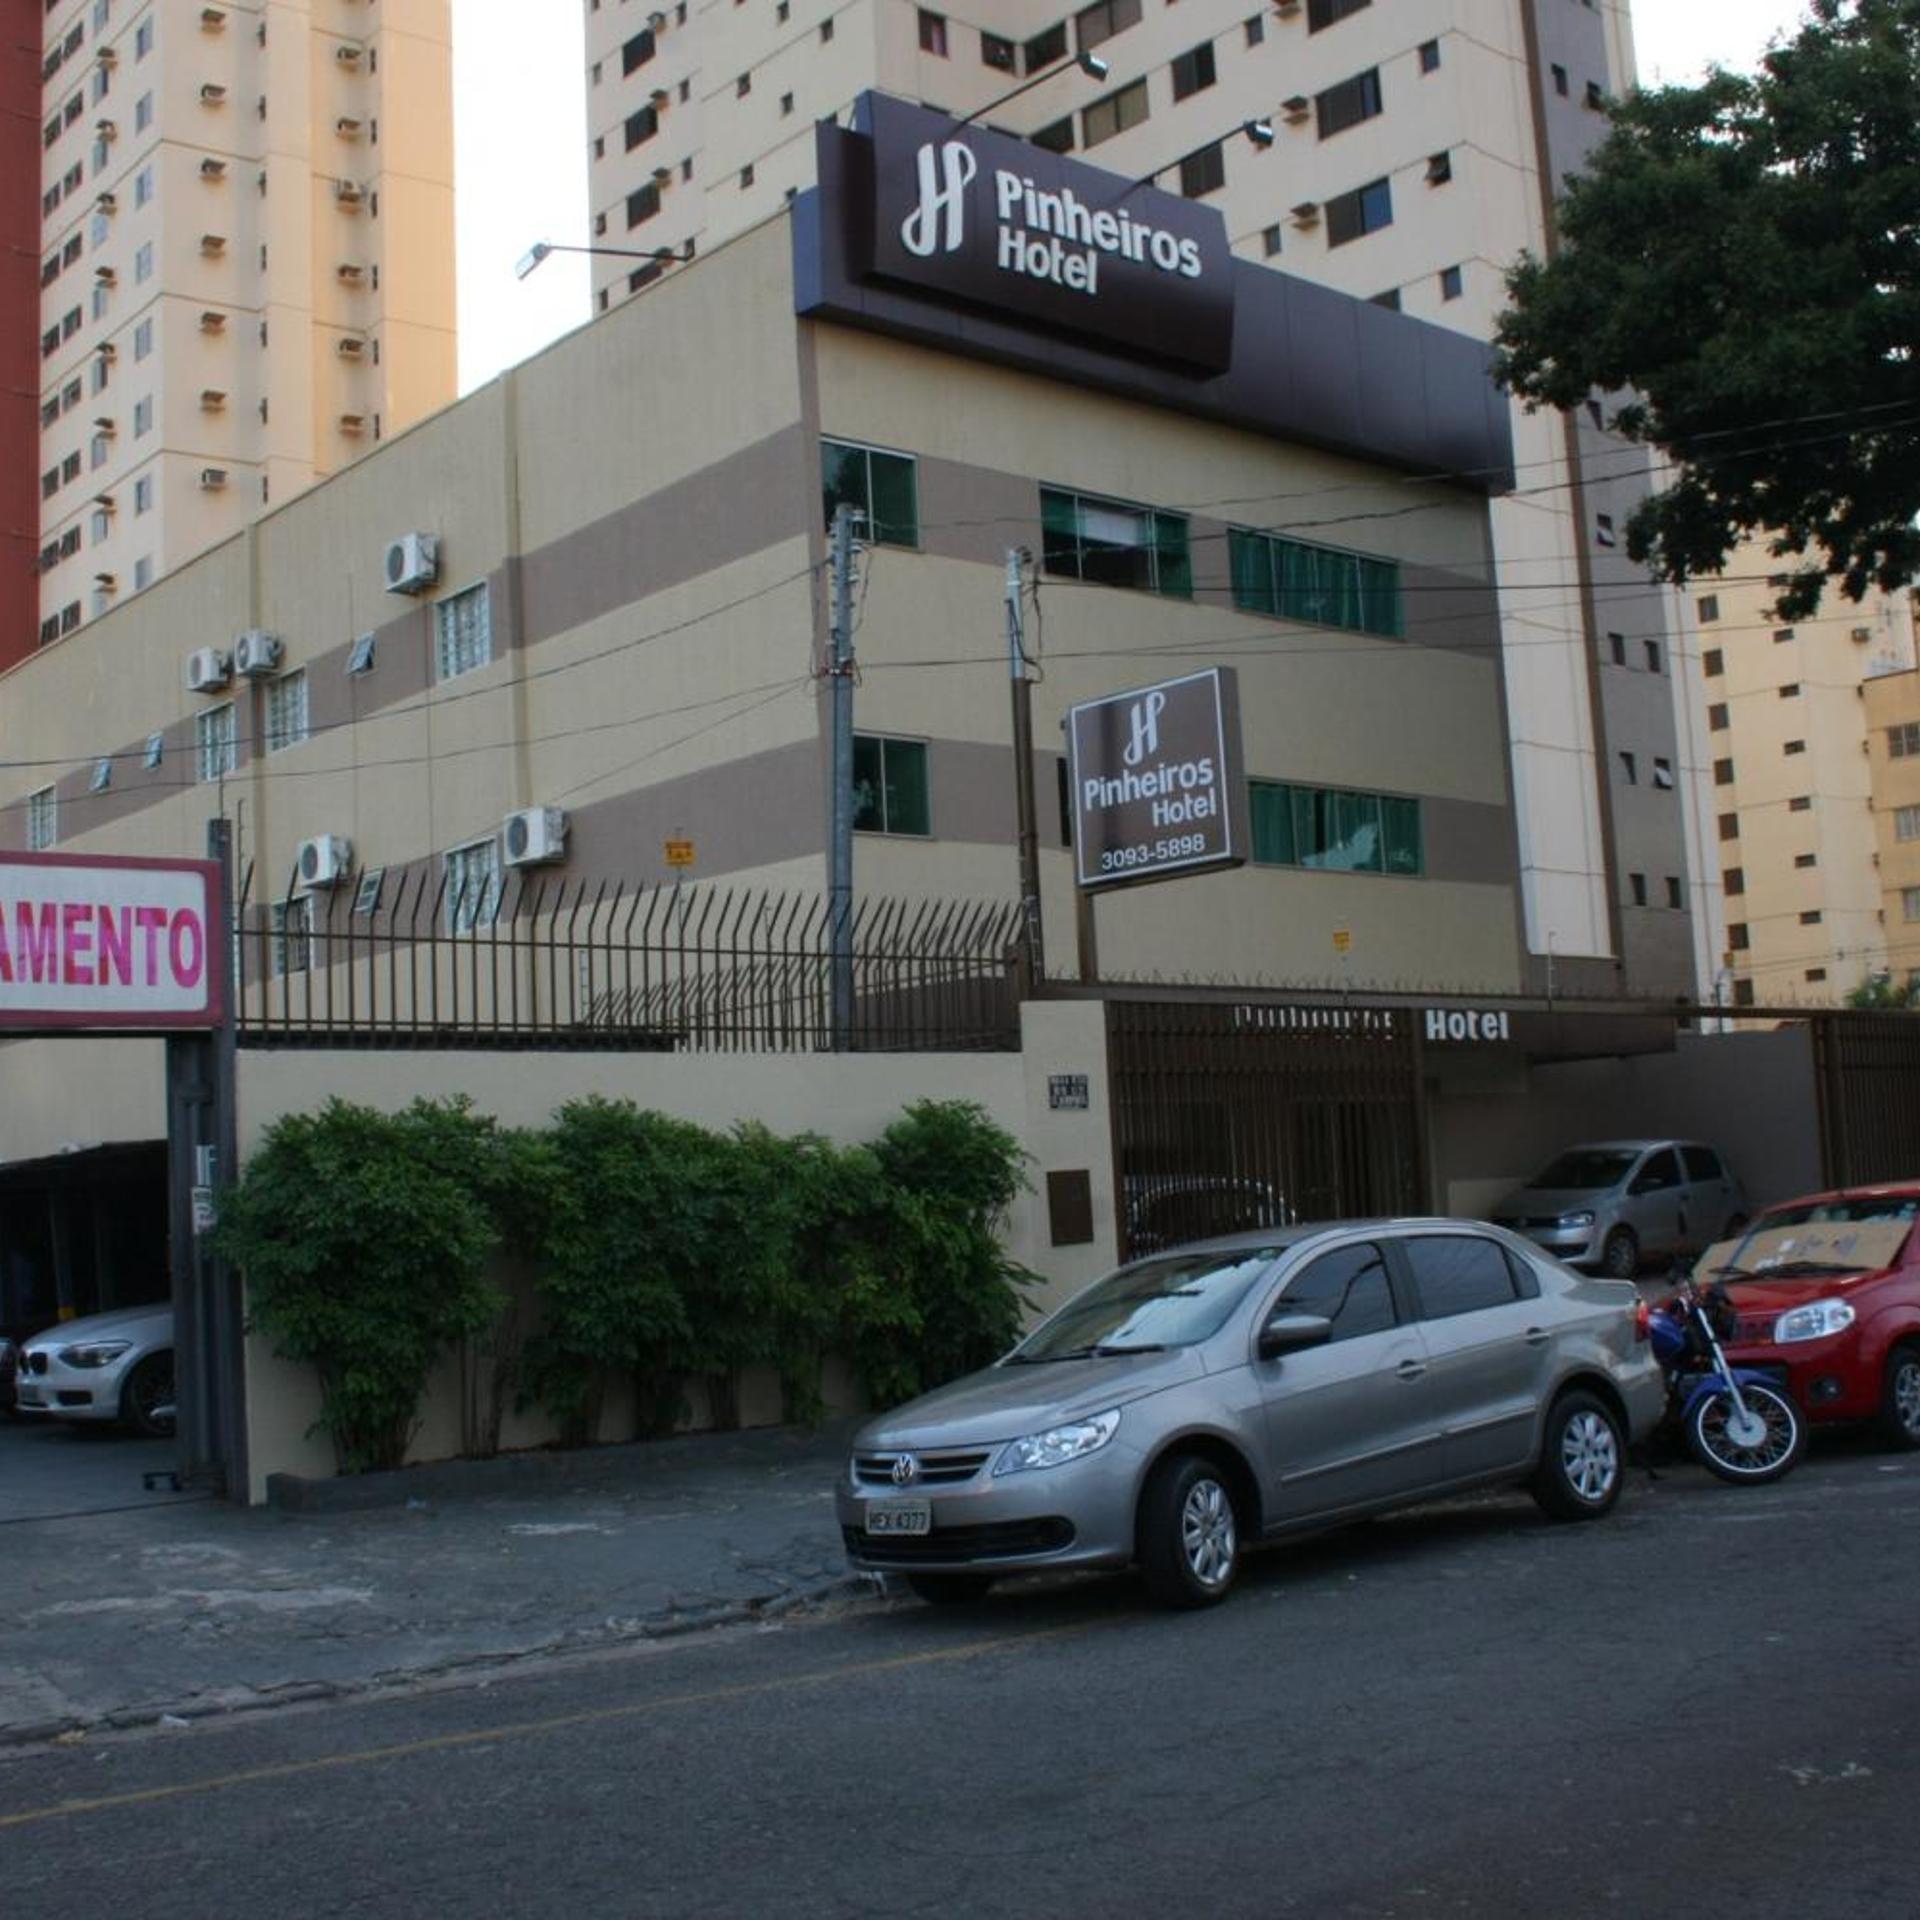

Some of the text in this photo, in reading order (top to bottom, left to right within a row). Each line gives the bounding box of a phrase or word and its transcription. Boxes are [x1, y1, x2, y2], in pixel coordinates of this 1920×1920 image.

[996, 169, 1202, 279] Pinheiros
[998, 225, 1098, 295] Hotel
[1084, 757, 1214, 811] Pinheiros
[1152, 788, 1217, 827] Hotel
[1101, 834, 1206, 870] 3093-5898
[1425, 1008, 1509, 1041] Hotel
